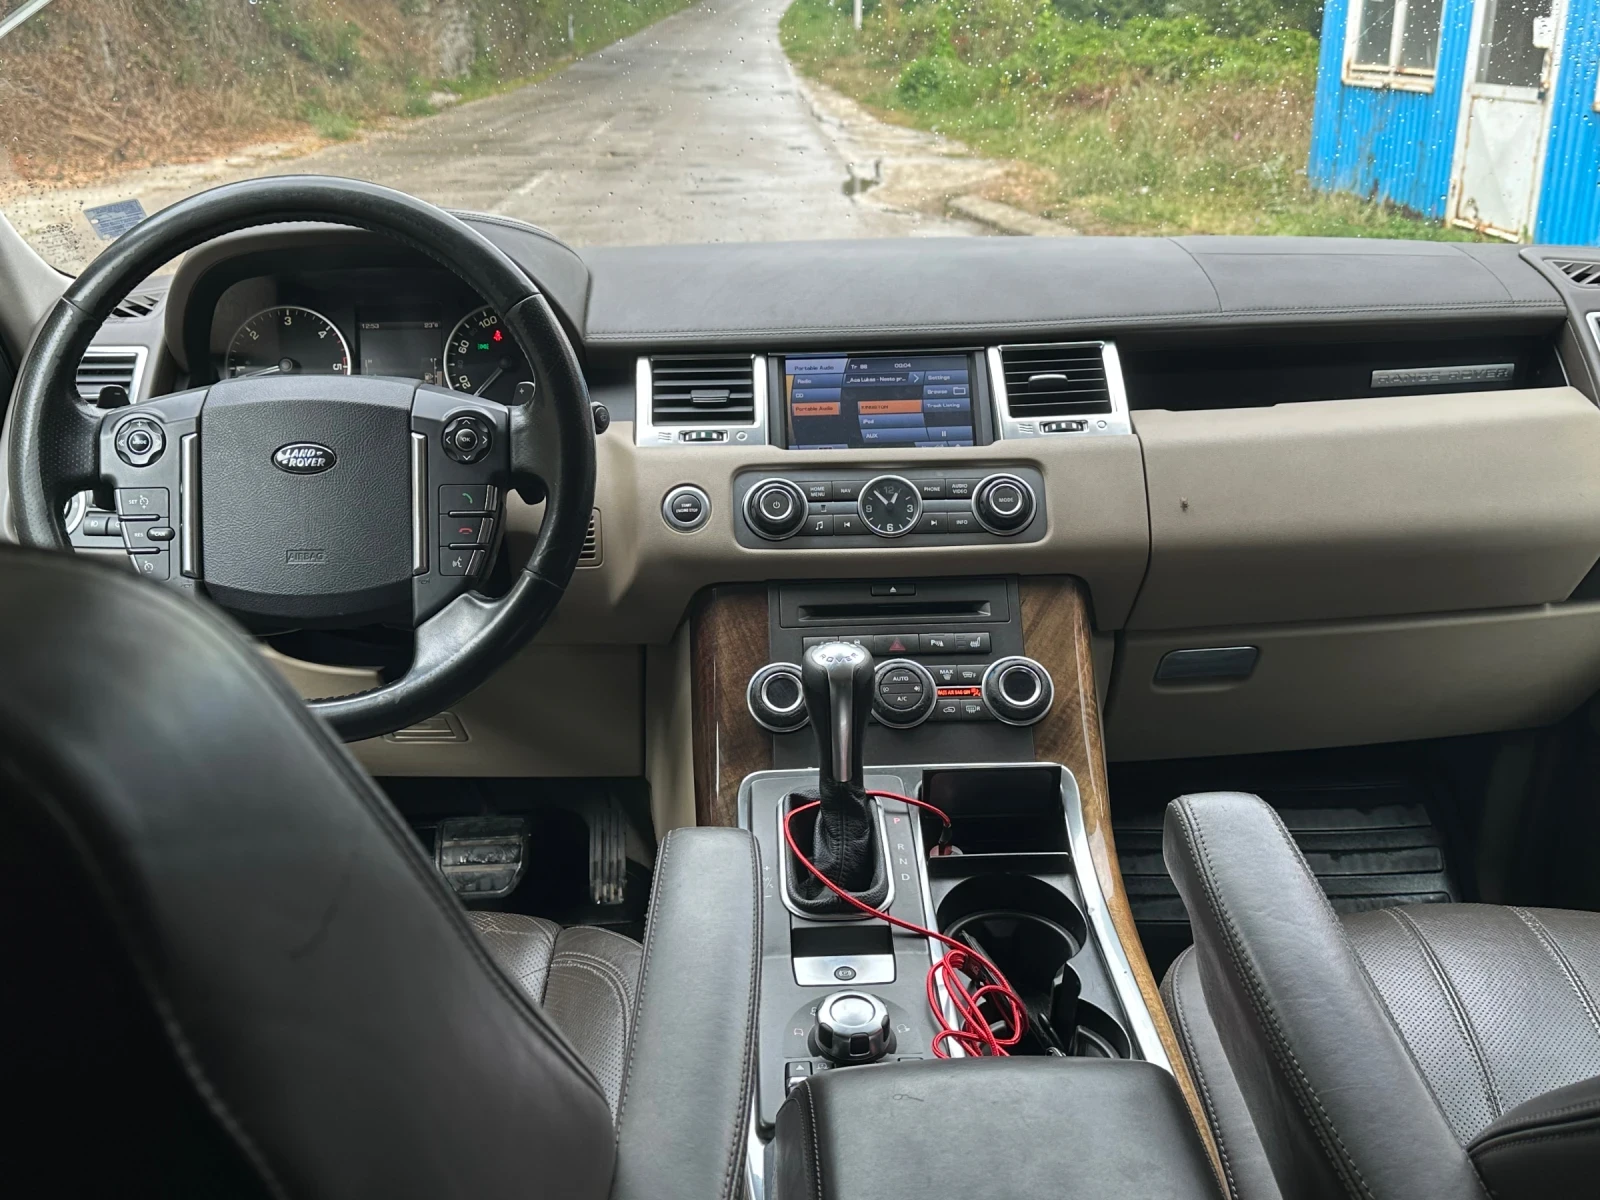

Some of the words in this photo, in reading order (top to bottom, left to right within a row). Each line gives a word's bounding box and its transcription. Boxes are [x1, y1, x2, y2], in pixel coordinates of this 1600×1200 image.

[284, 316, 292, 326] 3
[478, 315, 498, 328] 100
[249, 330, 260, 340] 2
[317, 330, 328, 339] 4
[458, 340, 470, 354] 60
[332, 363, 342, 371] 5
[928, 374, 950, 382] Settings
[1377, 371, 1441, 384] RANGE
[1448, 367, 1509, 380] ROVER
[458, 375, 471, 389] 20
[285, 448, 316, 458] LAND
[288, 457, 326, 467] ROVER
[884, 486, 895, 494] 12
[865, 504, 873, 513] 9
[906, 504, 914, 513] 3
[886, 523, 894, 532] 6
[288, 552, 324, 561] AIRBAG
[820, 652, 858, 663] ROVER
[893, 817, 901, 825] P
[901, 873, 910, 881] D
